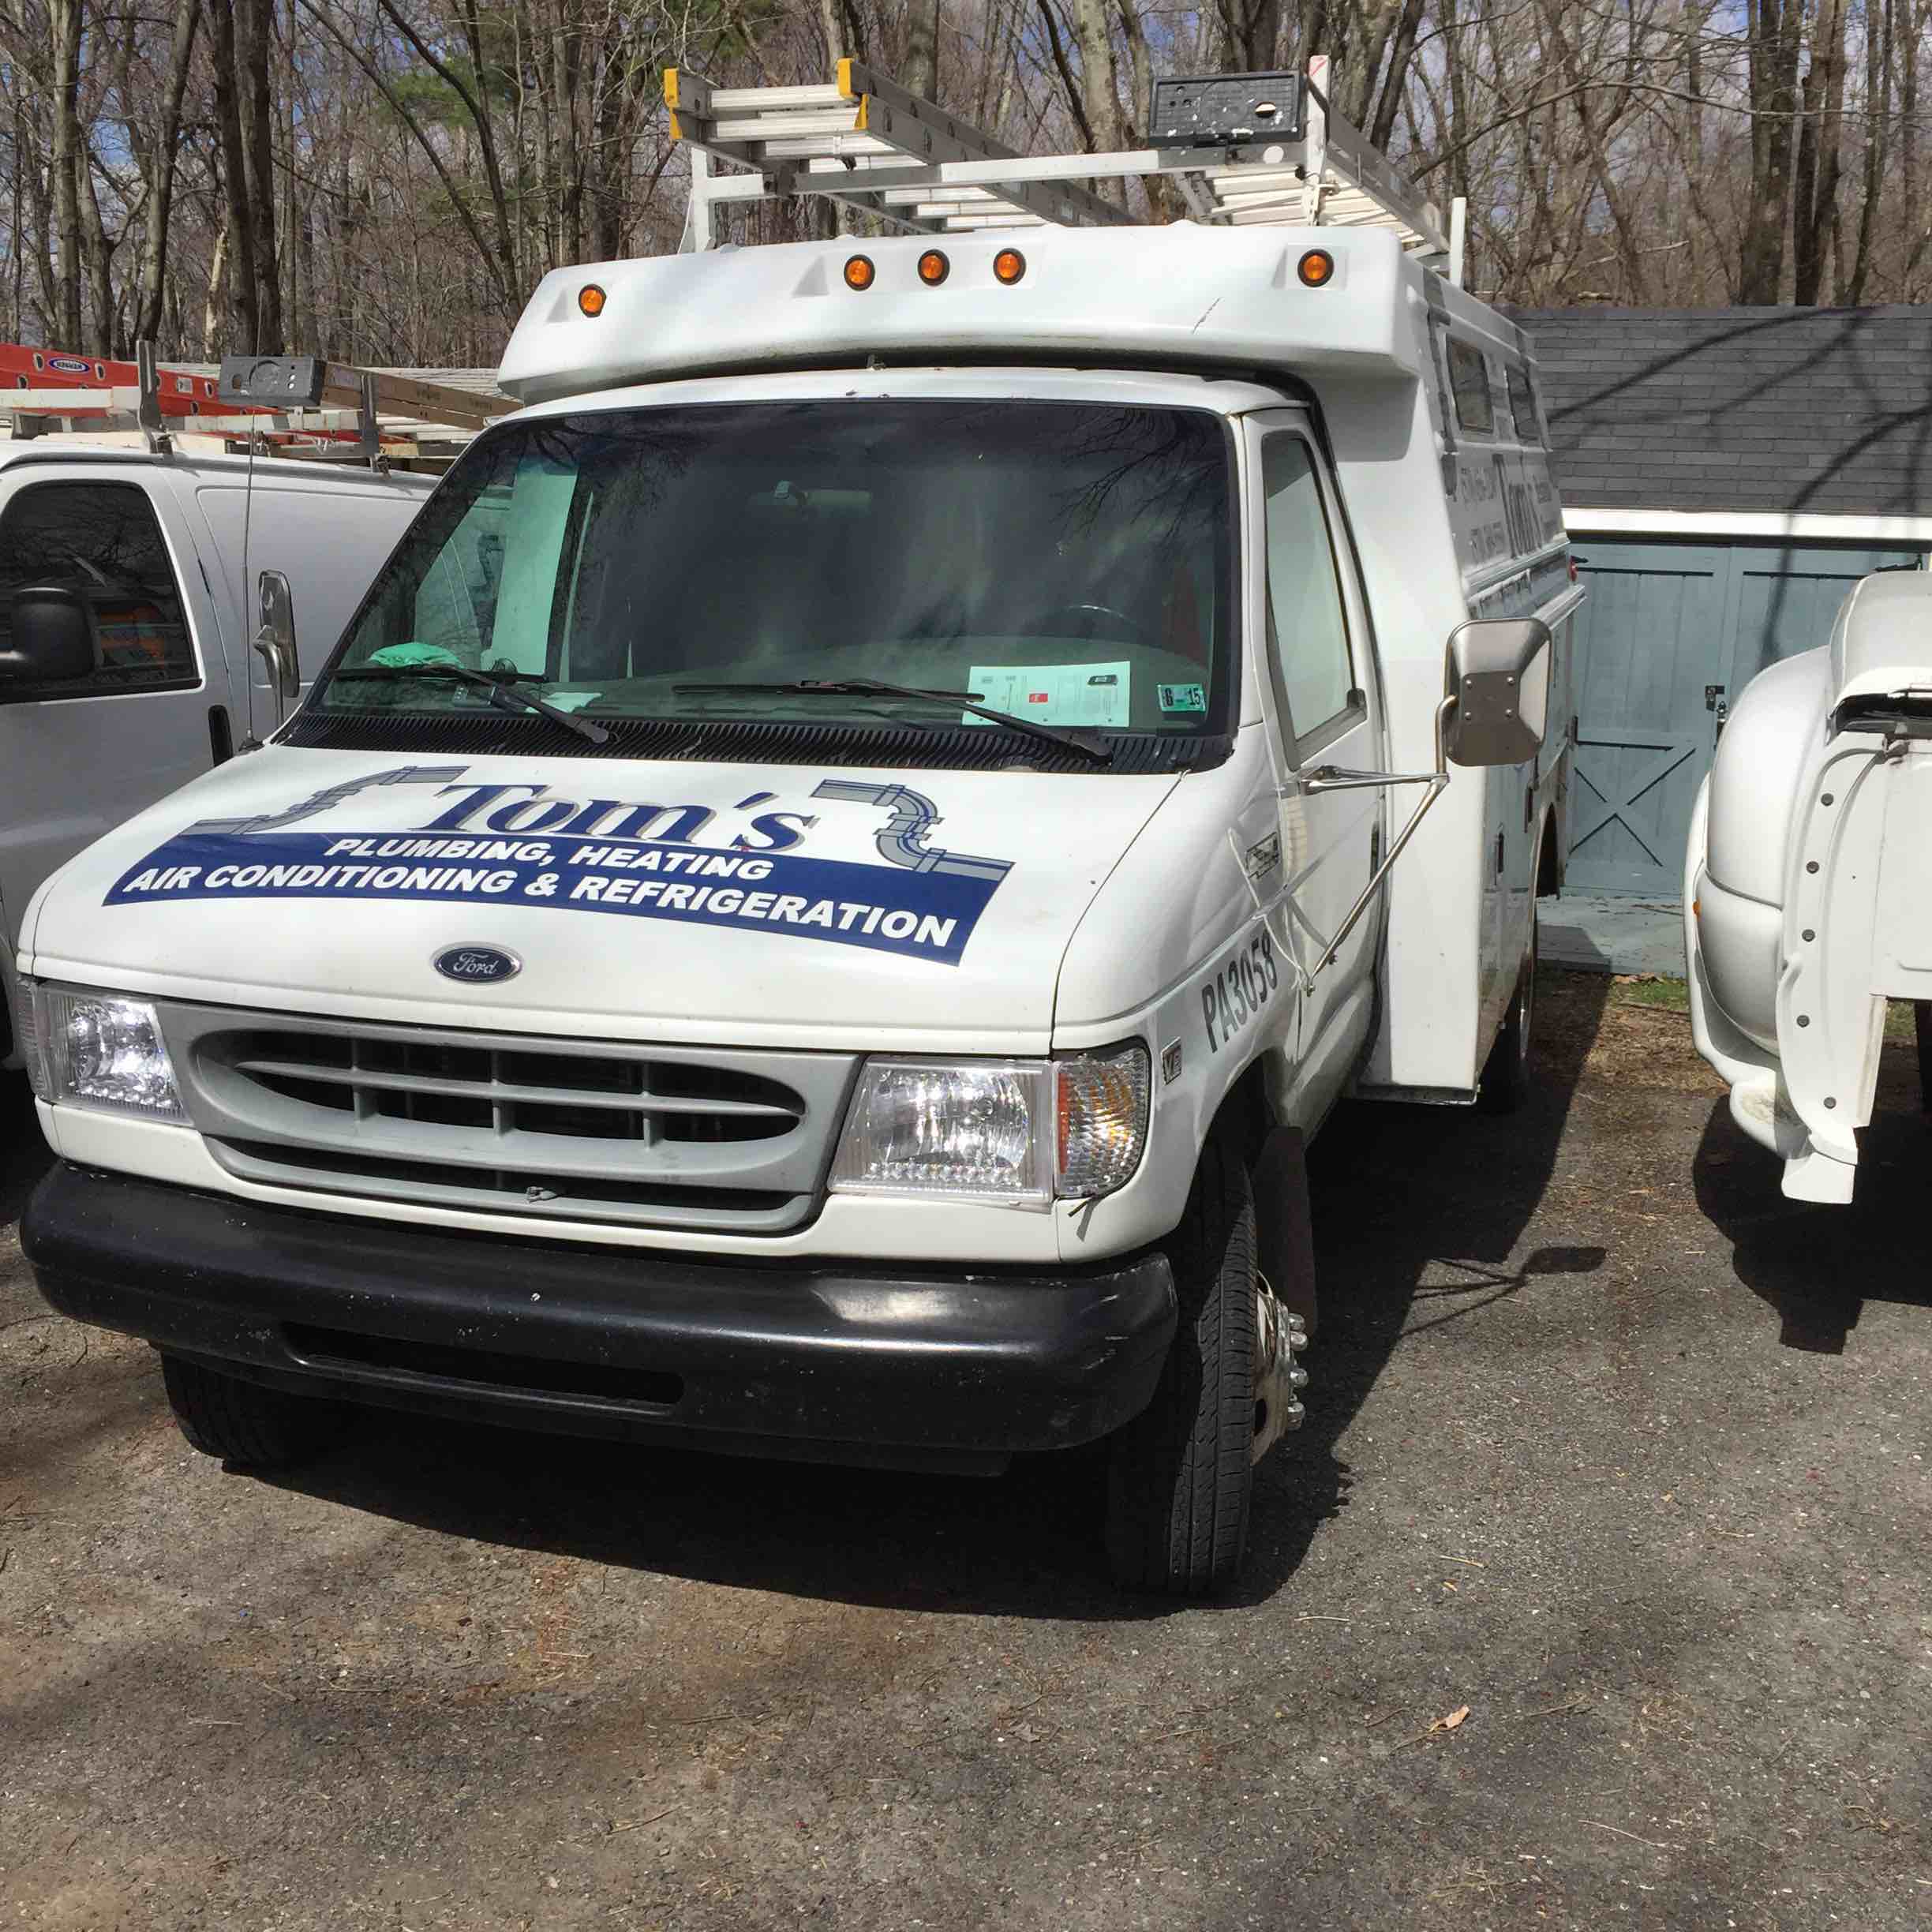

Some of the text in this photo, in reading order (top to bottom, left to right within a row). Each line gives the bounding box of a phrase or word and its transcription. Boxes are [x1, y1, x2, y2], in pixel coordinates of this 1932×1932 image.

[1186, 687, 1201, 706] 15
[409, 784, 821, 852] Tom's
[323, 838, 774, 881] PLUMBING, HEATING
[122, 864, 957, 948] AIR CONDITIONING & REFRIGERATION
[452, 953, 500, 975] Ford
[1201, 927, 1278, 1054] PA3058
